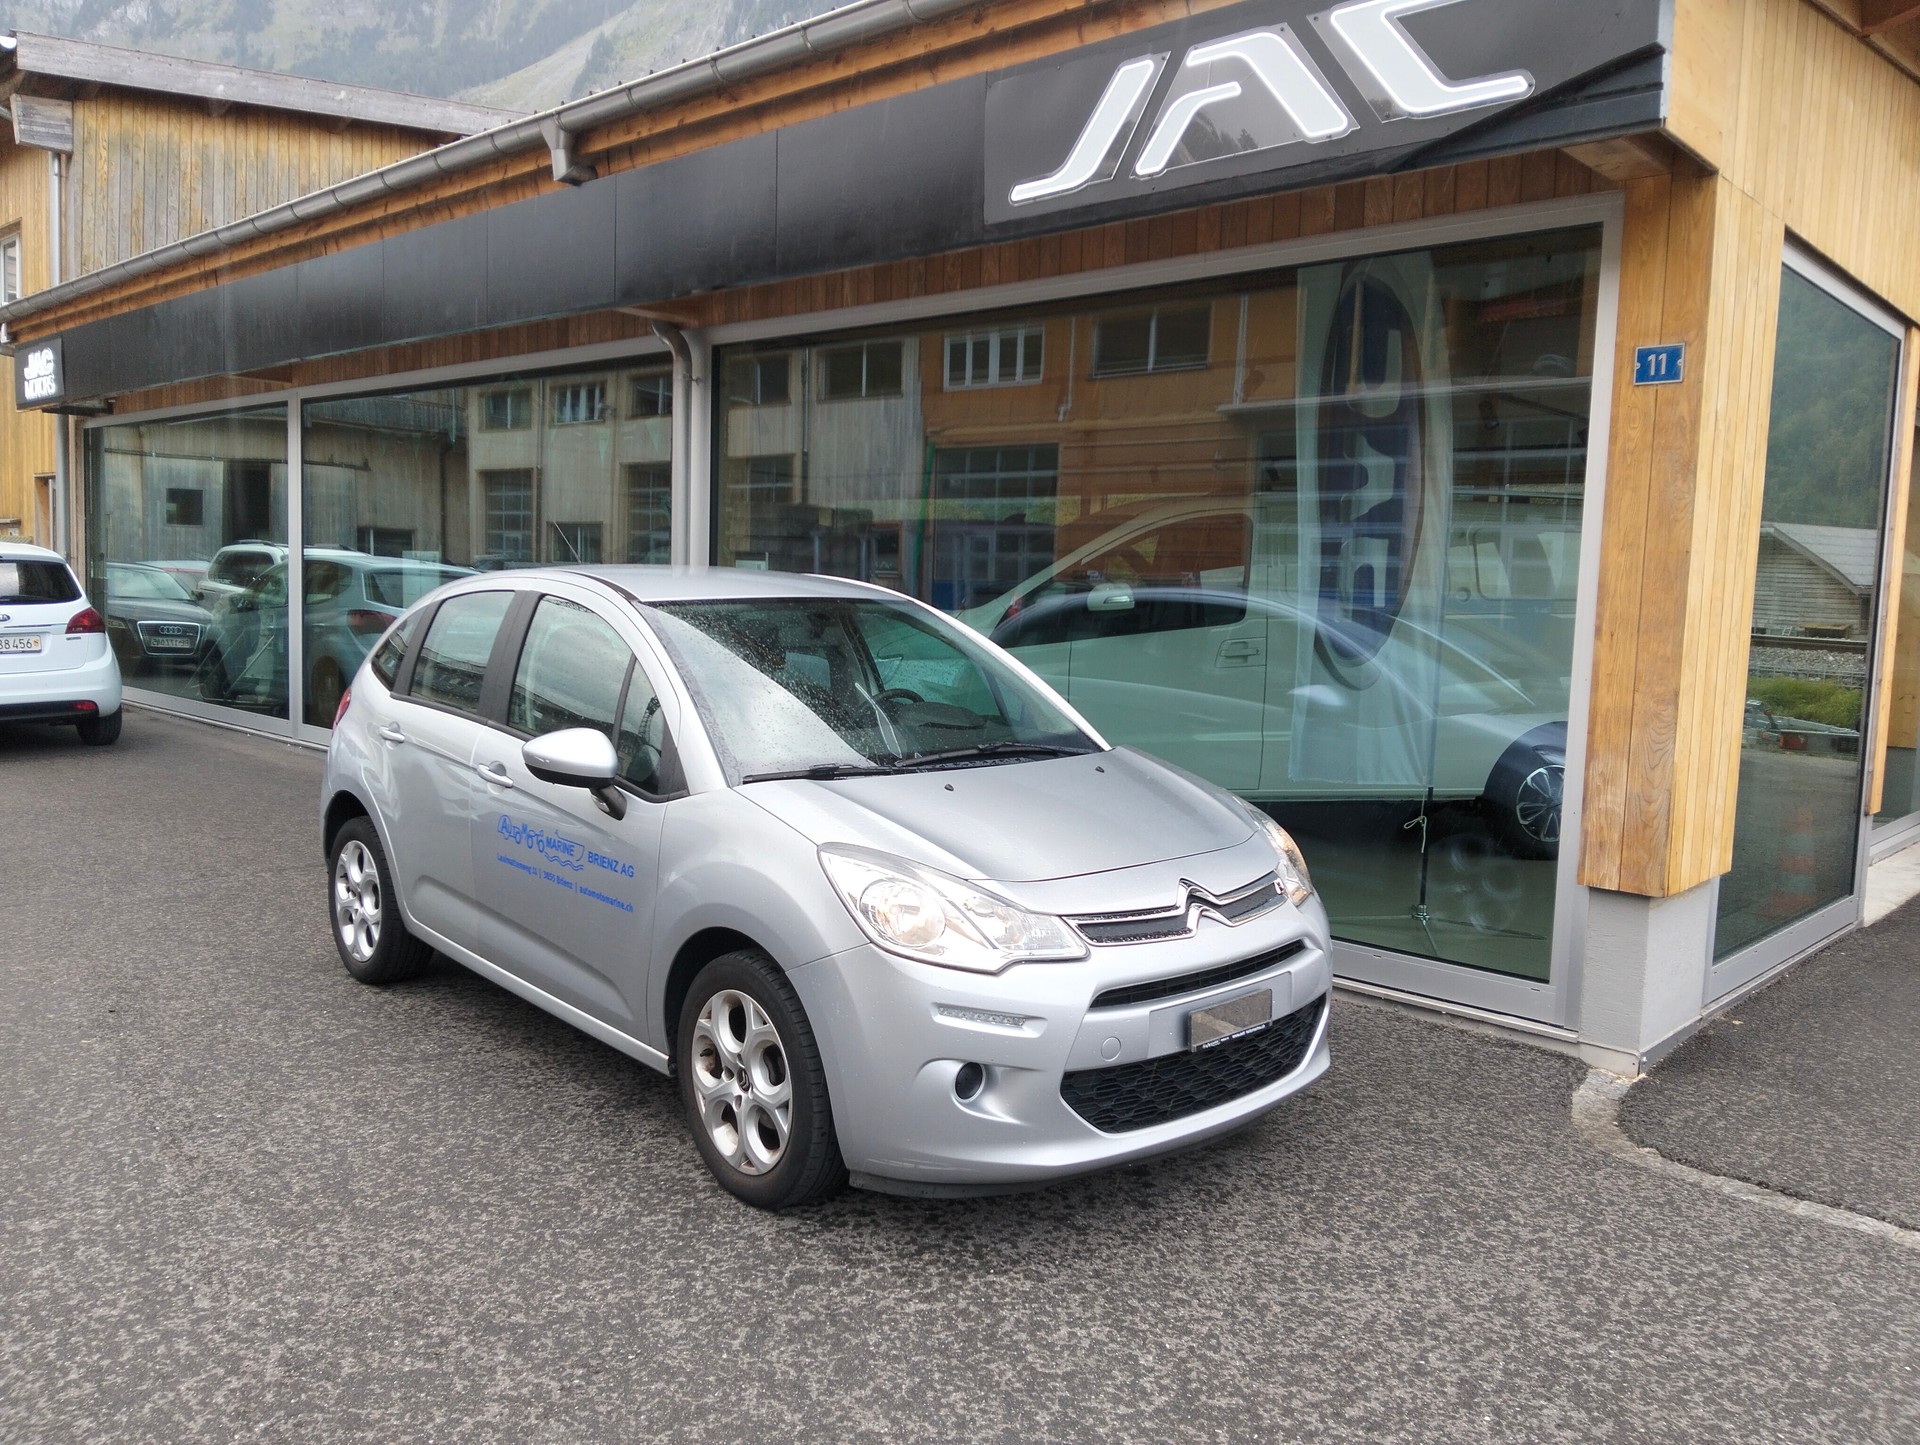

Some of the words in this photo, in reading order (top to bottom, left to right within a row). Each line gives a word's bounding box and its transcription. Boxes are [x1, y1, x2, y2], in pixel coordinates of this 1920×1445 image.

[1647, 353, 1667, 376] 11
[545, 837, 575, 858] MARINE
[587, 851, 618, 873] BRIENZ
[620, 862, 635, 878] AG
